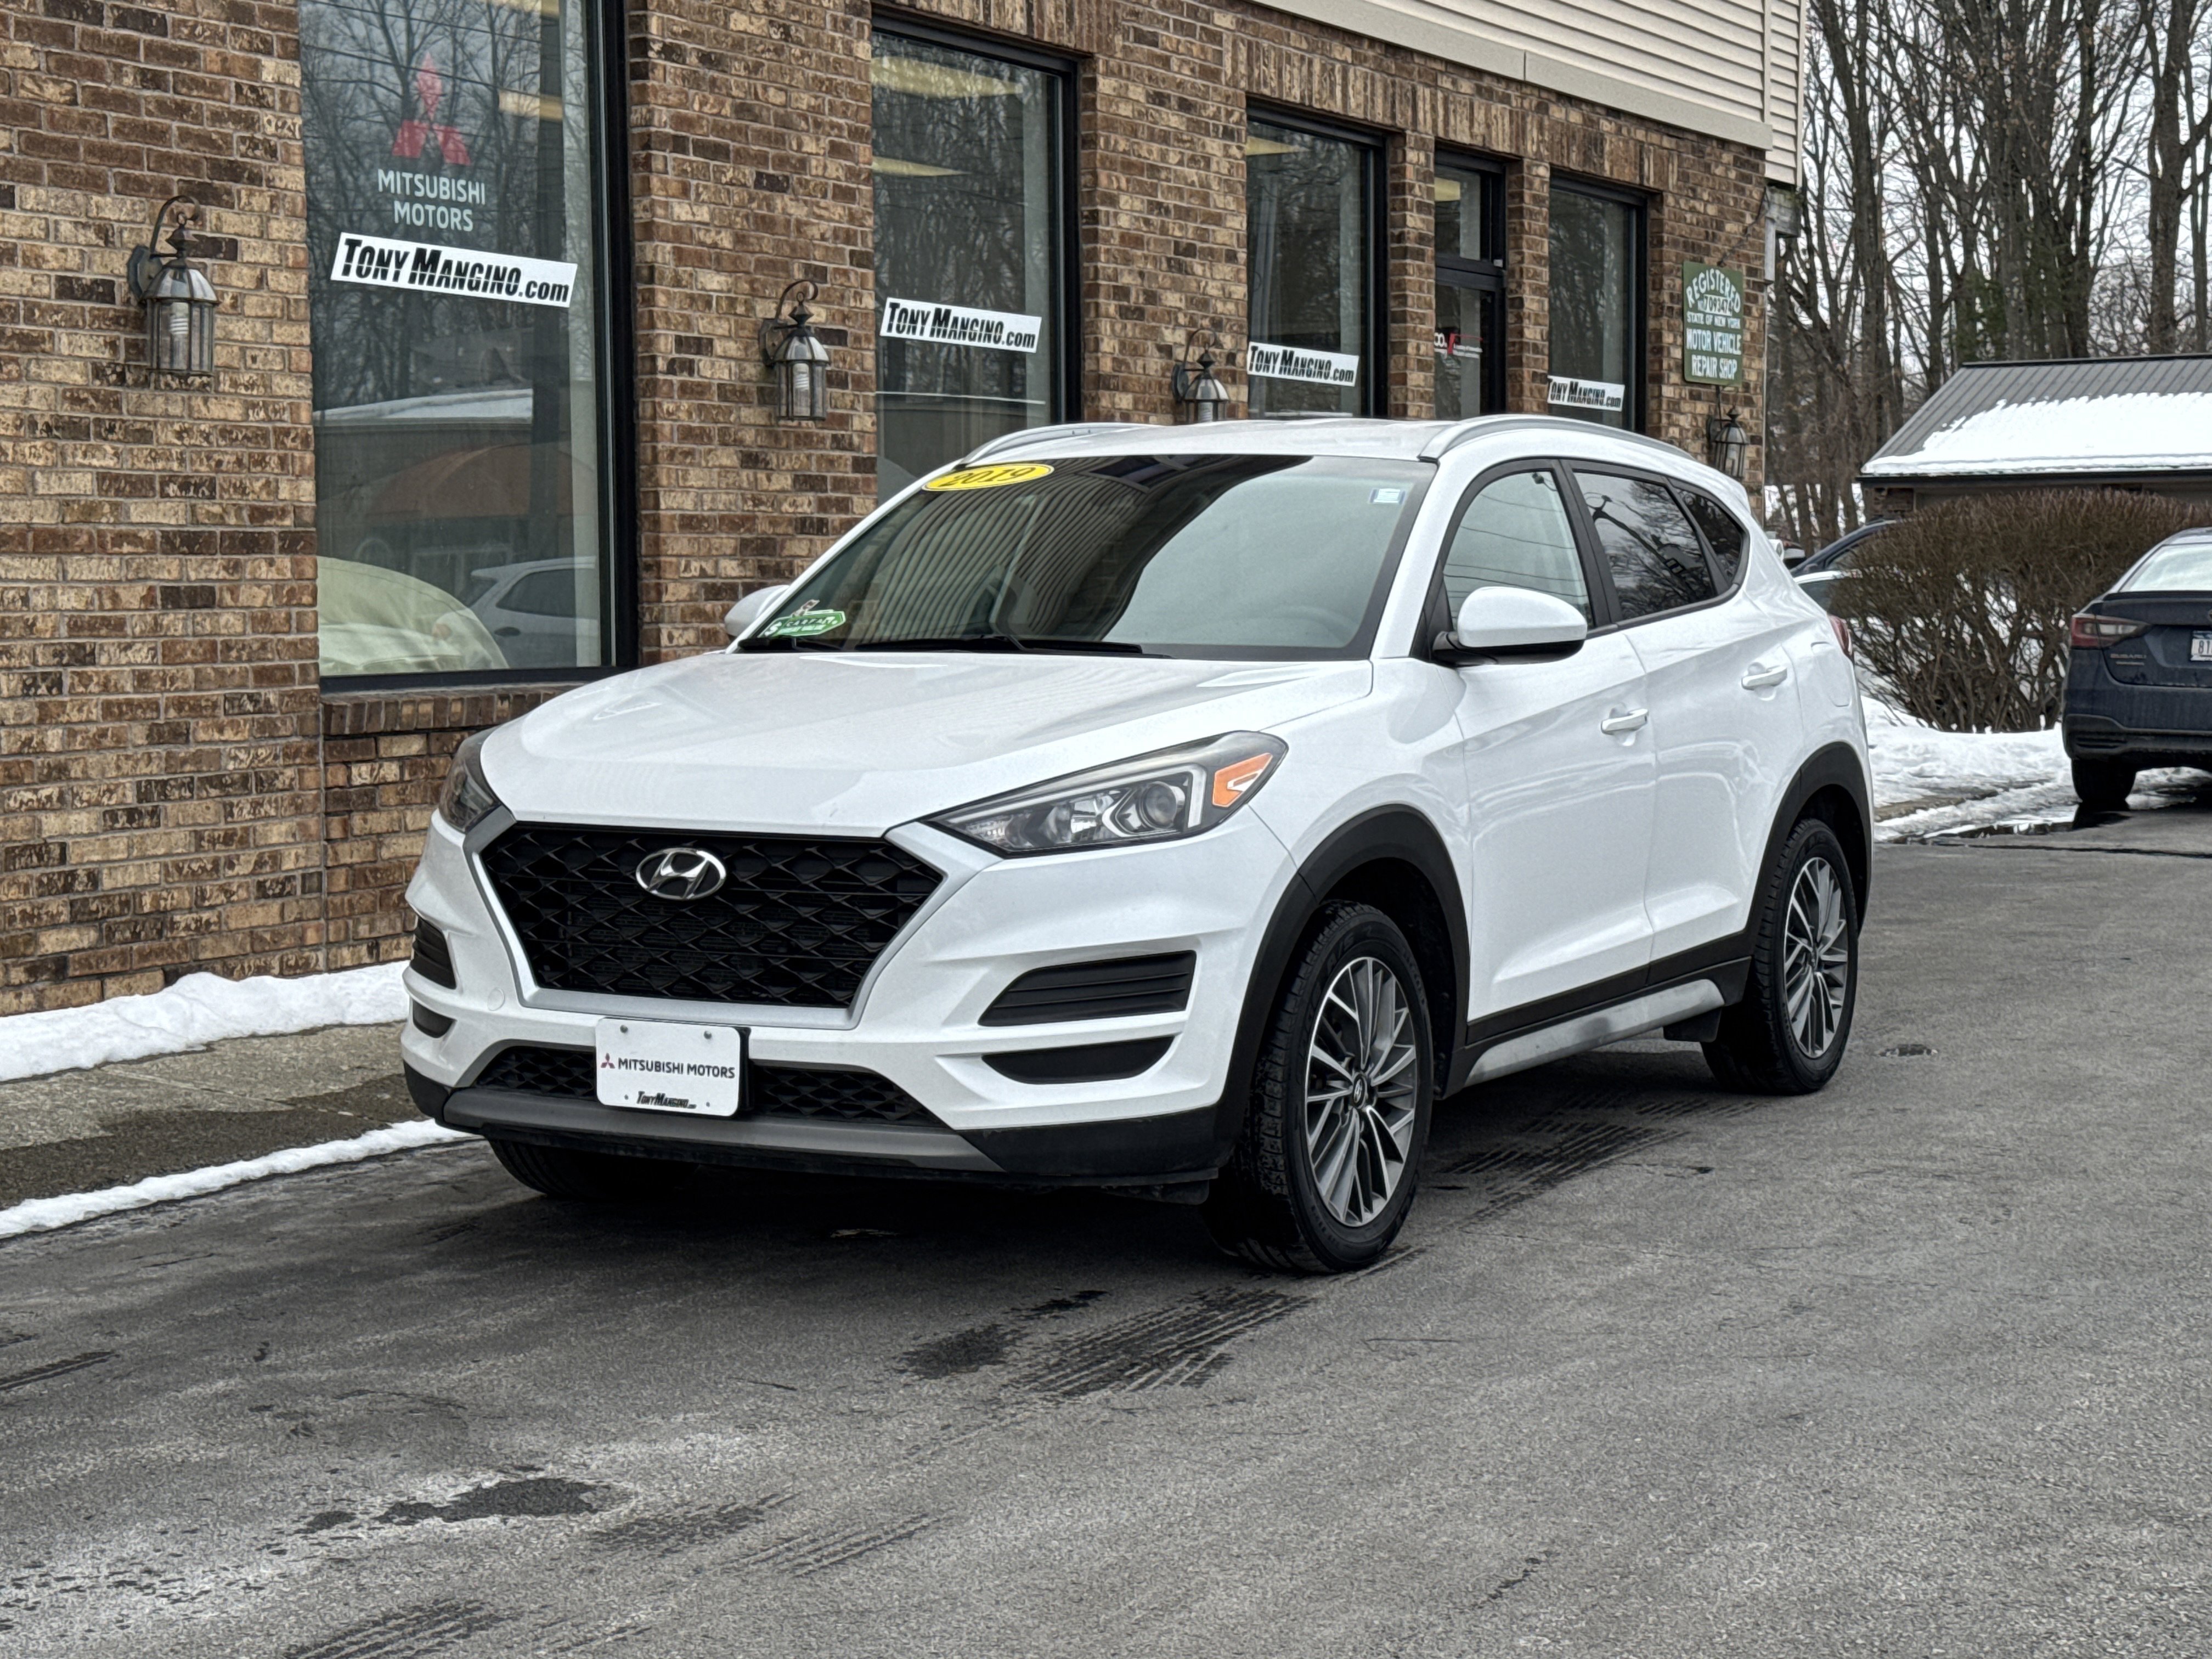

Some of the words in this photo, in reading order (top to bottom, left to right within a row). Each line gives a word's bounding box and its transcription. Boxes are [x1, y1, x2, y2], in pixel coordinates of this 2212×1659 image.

[377, 168, 486, 205] MITSUBISHI
[393, 201, 473, 232] MOTORS
[1686, 268, 1741, 313] REGISTERED
[1686, 311, 1704, 325] STATE
[1706, 314, 1713, 325] OF
[1686, 328, 1712, 352] MOTOR
[1713, 331, 1742, 356] VEHICLE
[1691, 354, 1718, 378] REPAIR
[1719, 358, 1737, 380] SHOP
[938, 467, 1036, 487] 2019
[2198, 640, 2212, 654] 81
[618, 1057, 684, 1075] MITSUBISHI
[687, 1063, 736, 1079] MOTORS
